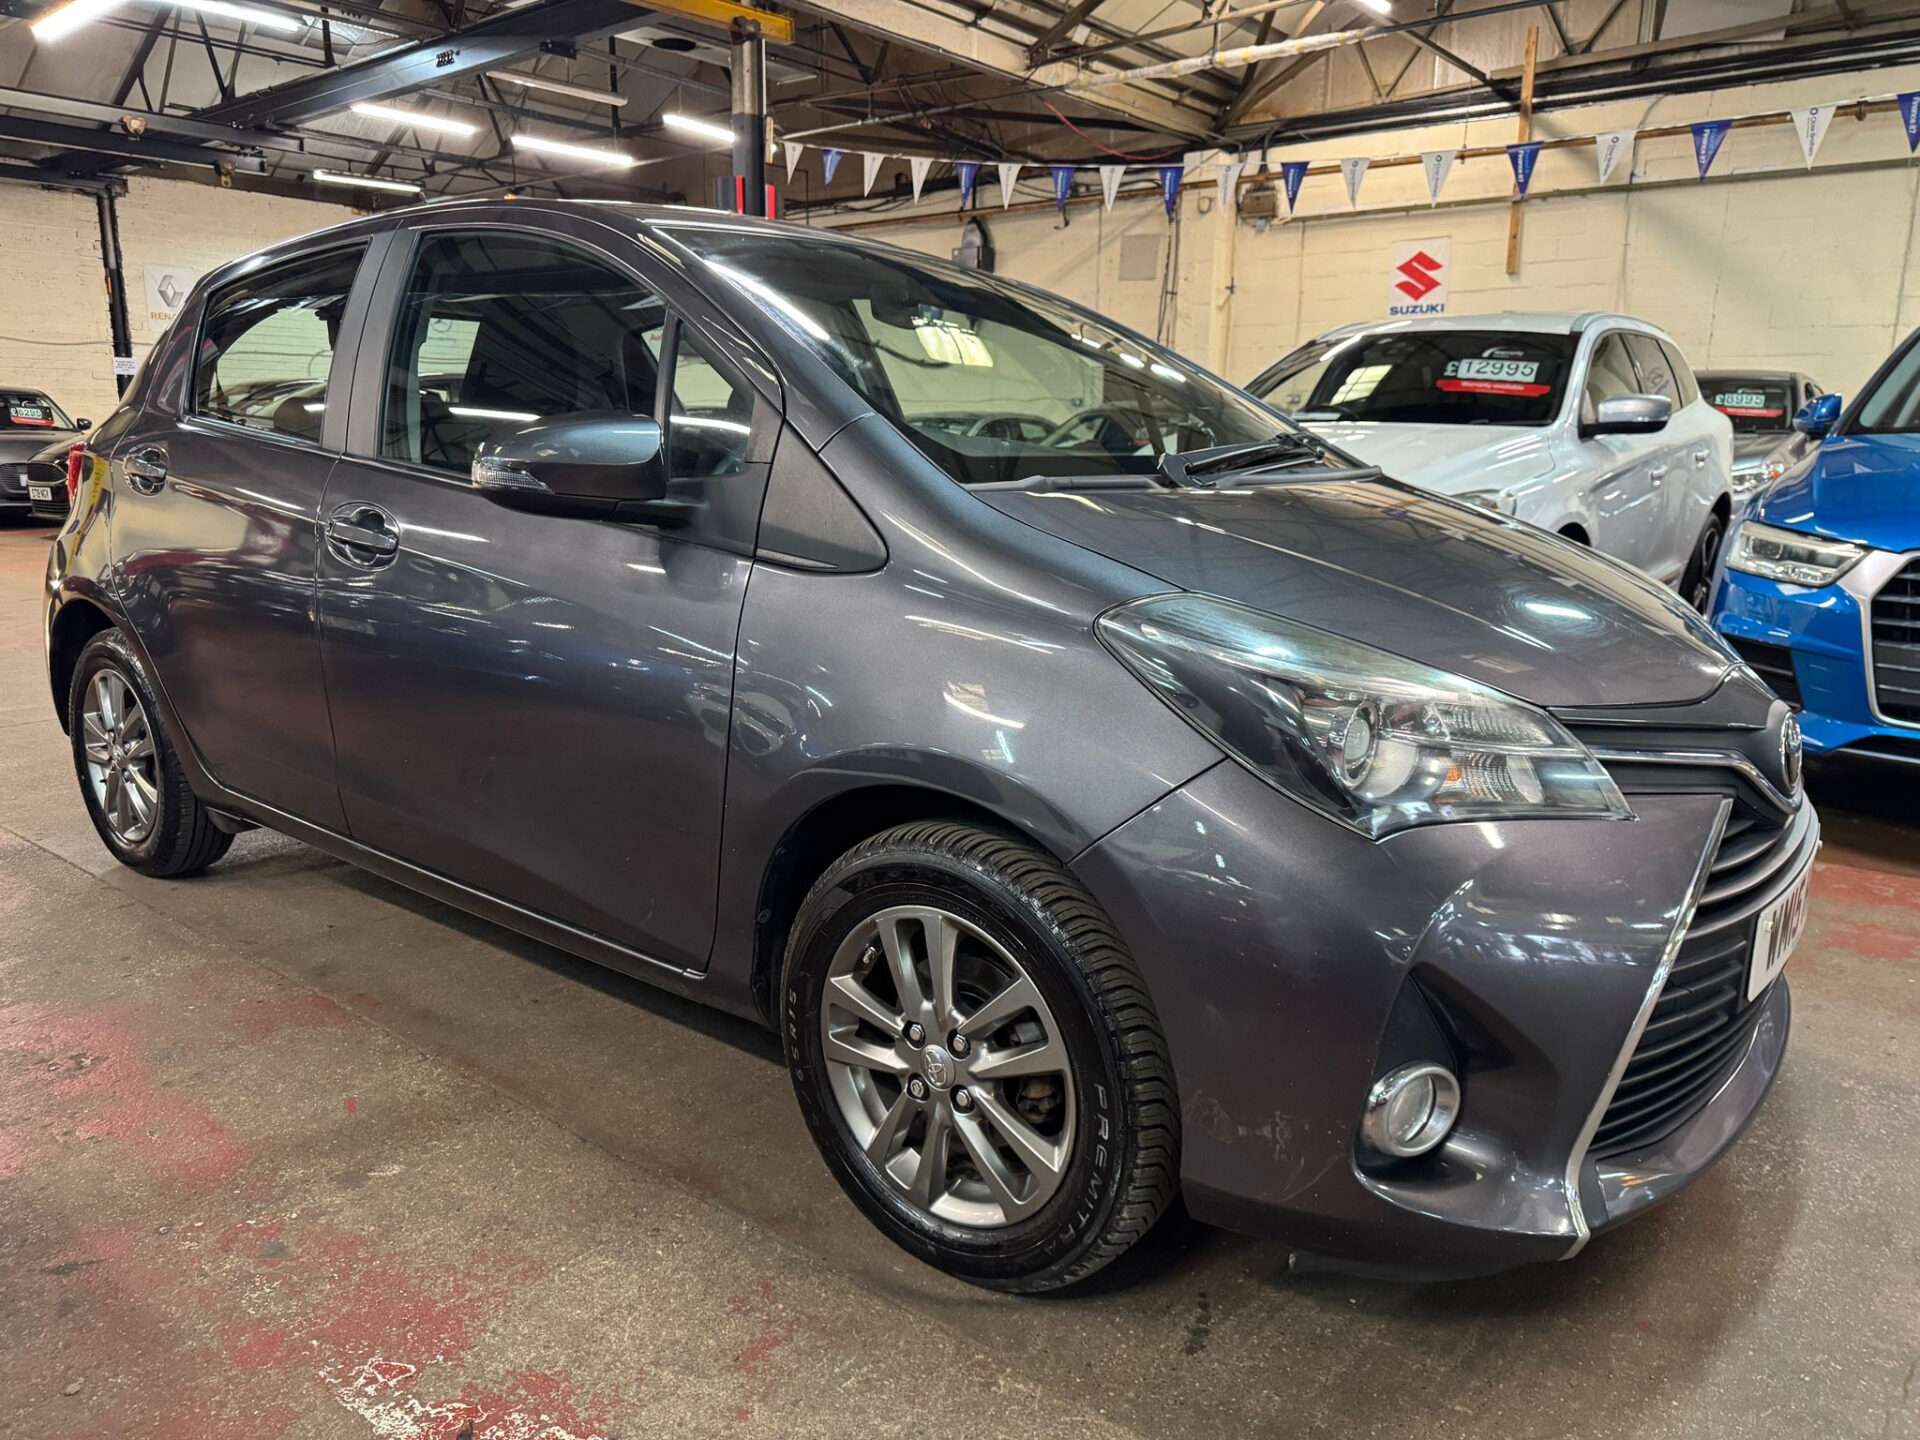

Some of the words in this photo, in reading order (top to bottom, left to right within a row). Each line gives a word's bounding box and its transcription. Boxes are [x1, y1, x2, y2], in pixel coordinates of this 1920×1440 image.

[1390, 304, 1444, 316] SUZUKI
[1443, 360, 1534, 377] £12995
[1043, 1083, 1110, 1255] PREMITRA
